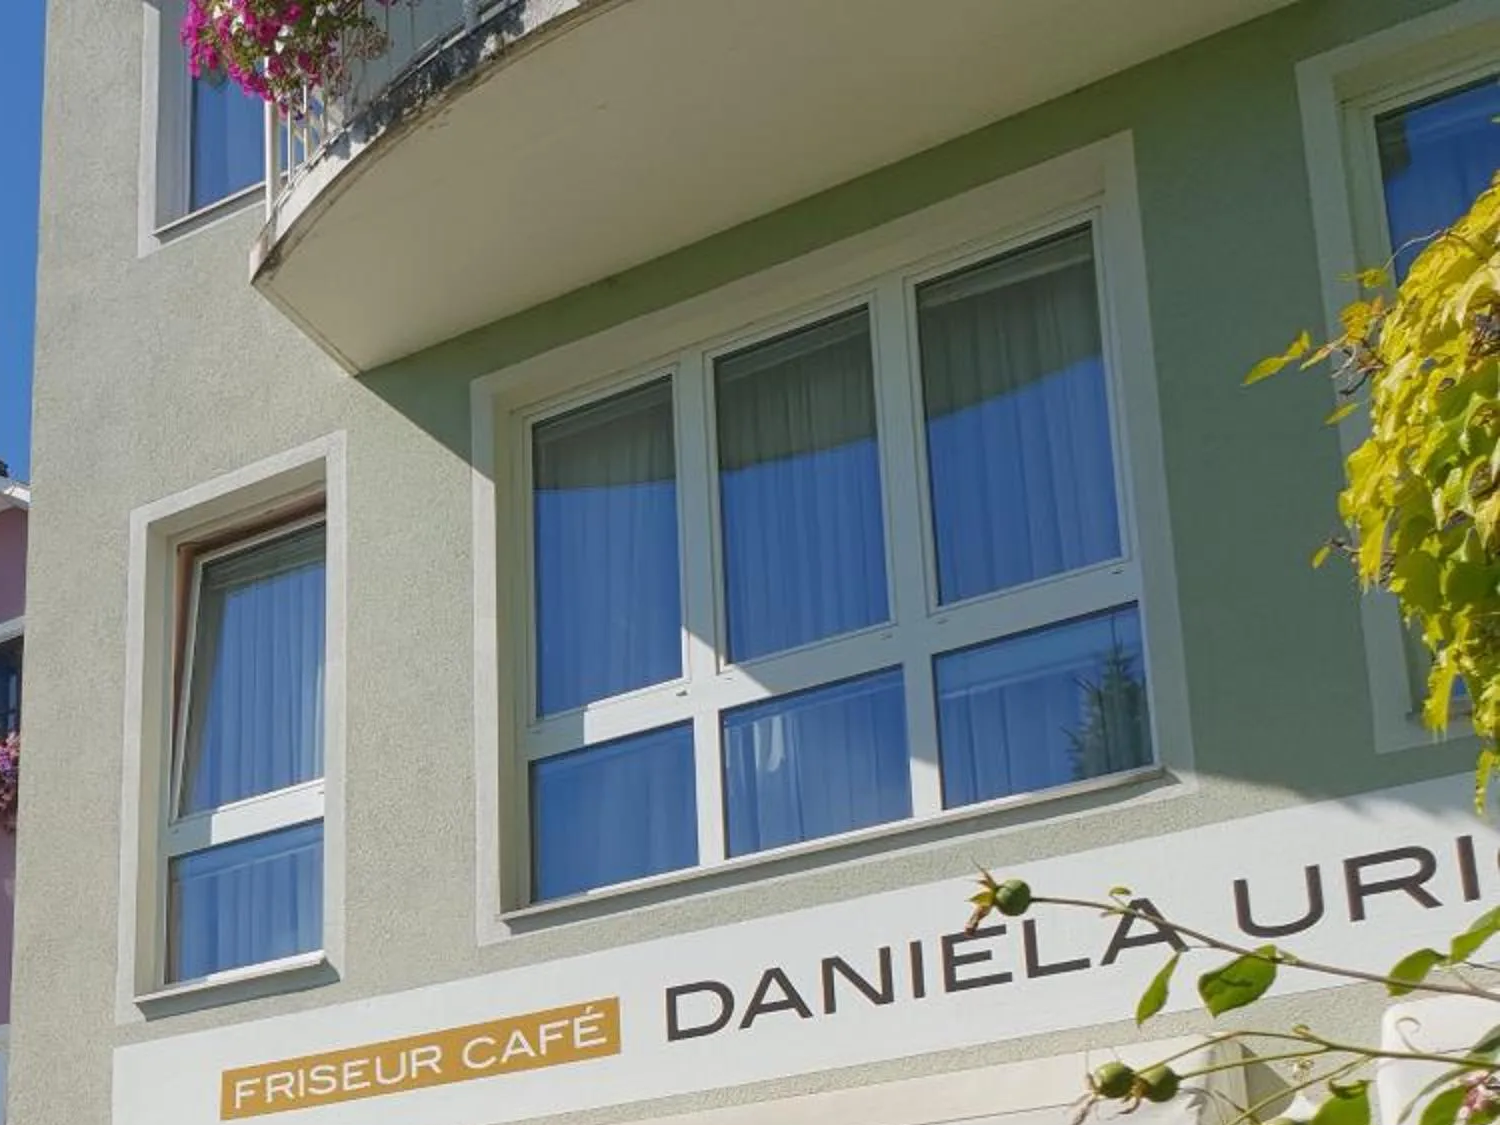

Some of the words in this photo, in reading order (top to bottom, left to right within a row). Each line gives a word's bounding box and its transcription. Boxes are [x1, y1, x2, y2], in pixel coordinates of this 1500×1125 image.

[233, 1045, 442, 1110] FRISEUR
[461, 1005, 606, 1070] CAFÉ
[665, 896, 1188, 1042] DANIELA
[1233, 834, 1500, 939] URI
